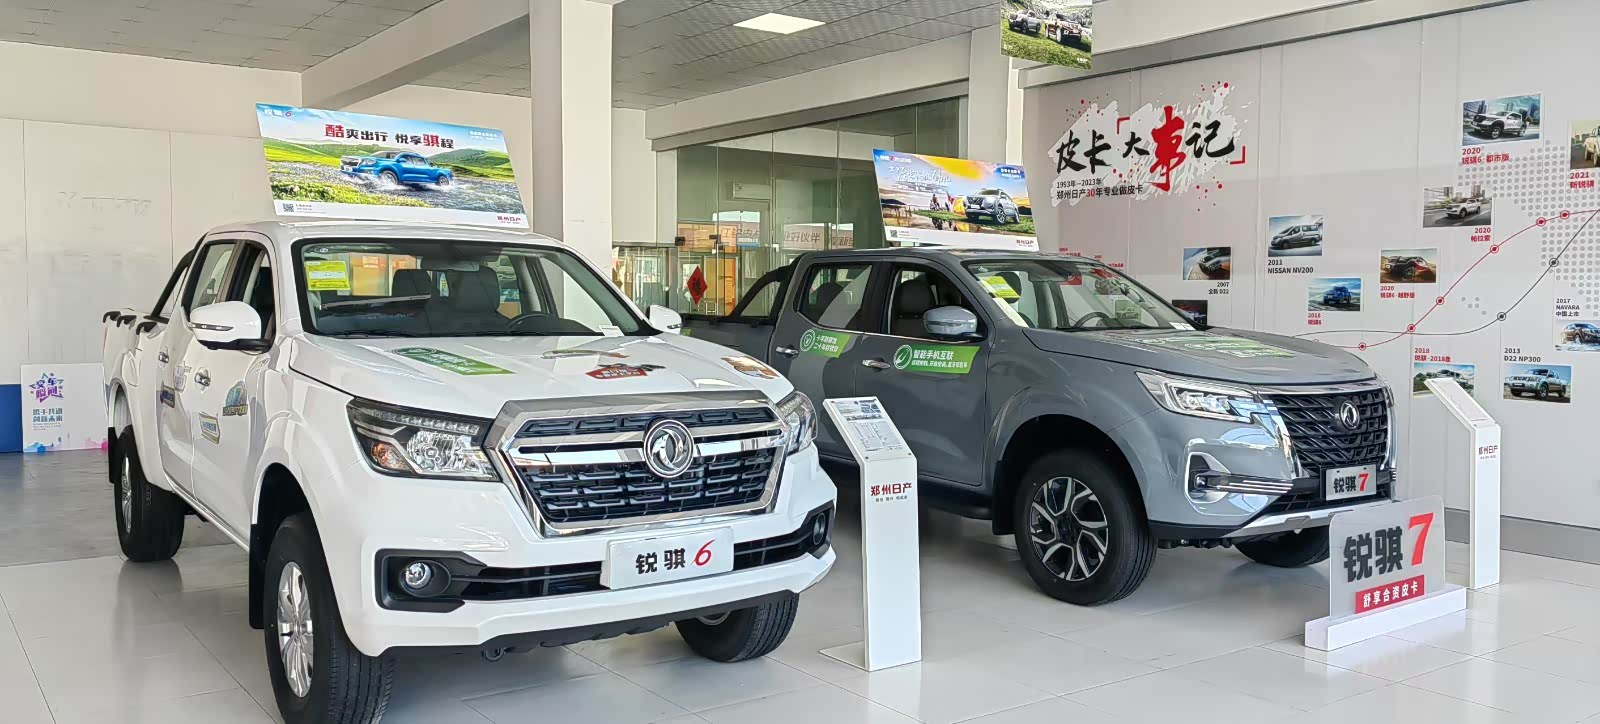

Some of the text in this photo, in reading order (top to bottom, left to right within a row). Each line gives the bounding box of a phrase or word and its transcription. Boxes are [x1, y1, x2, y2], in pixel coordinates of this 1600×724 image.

[325, 123, 389, 143] 酷爽出行
[395, 132, 455, 151] 悦享骐程
[1462, 147, 1481, 155] 2020
[1056, 183, 1143, 200] 郑州日产30年专业做皮卡
[1570, 180, 1595, 189] 新锐骐
[913, 349, 954, 361] 智能手机互联
[870, 482, 912, 497] 郑州日产
[1333, 473, 1369, 494] 锐骐7
[635, 538, 717, 575] 锐骐6
[1343, 512, 1434, 583] 锐骐7
[1363, 580, 1418, 608] 舒享合资皮卡
